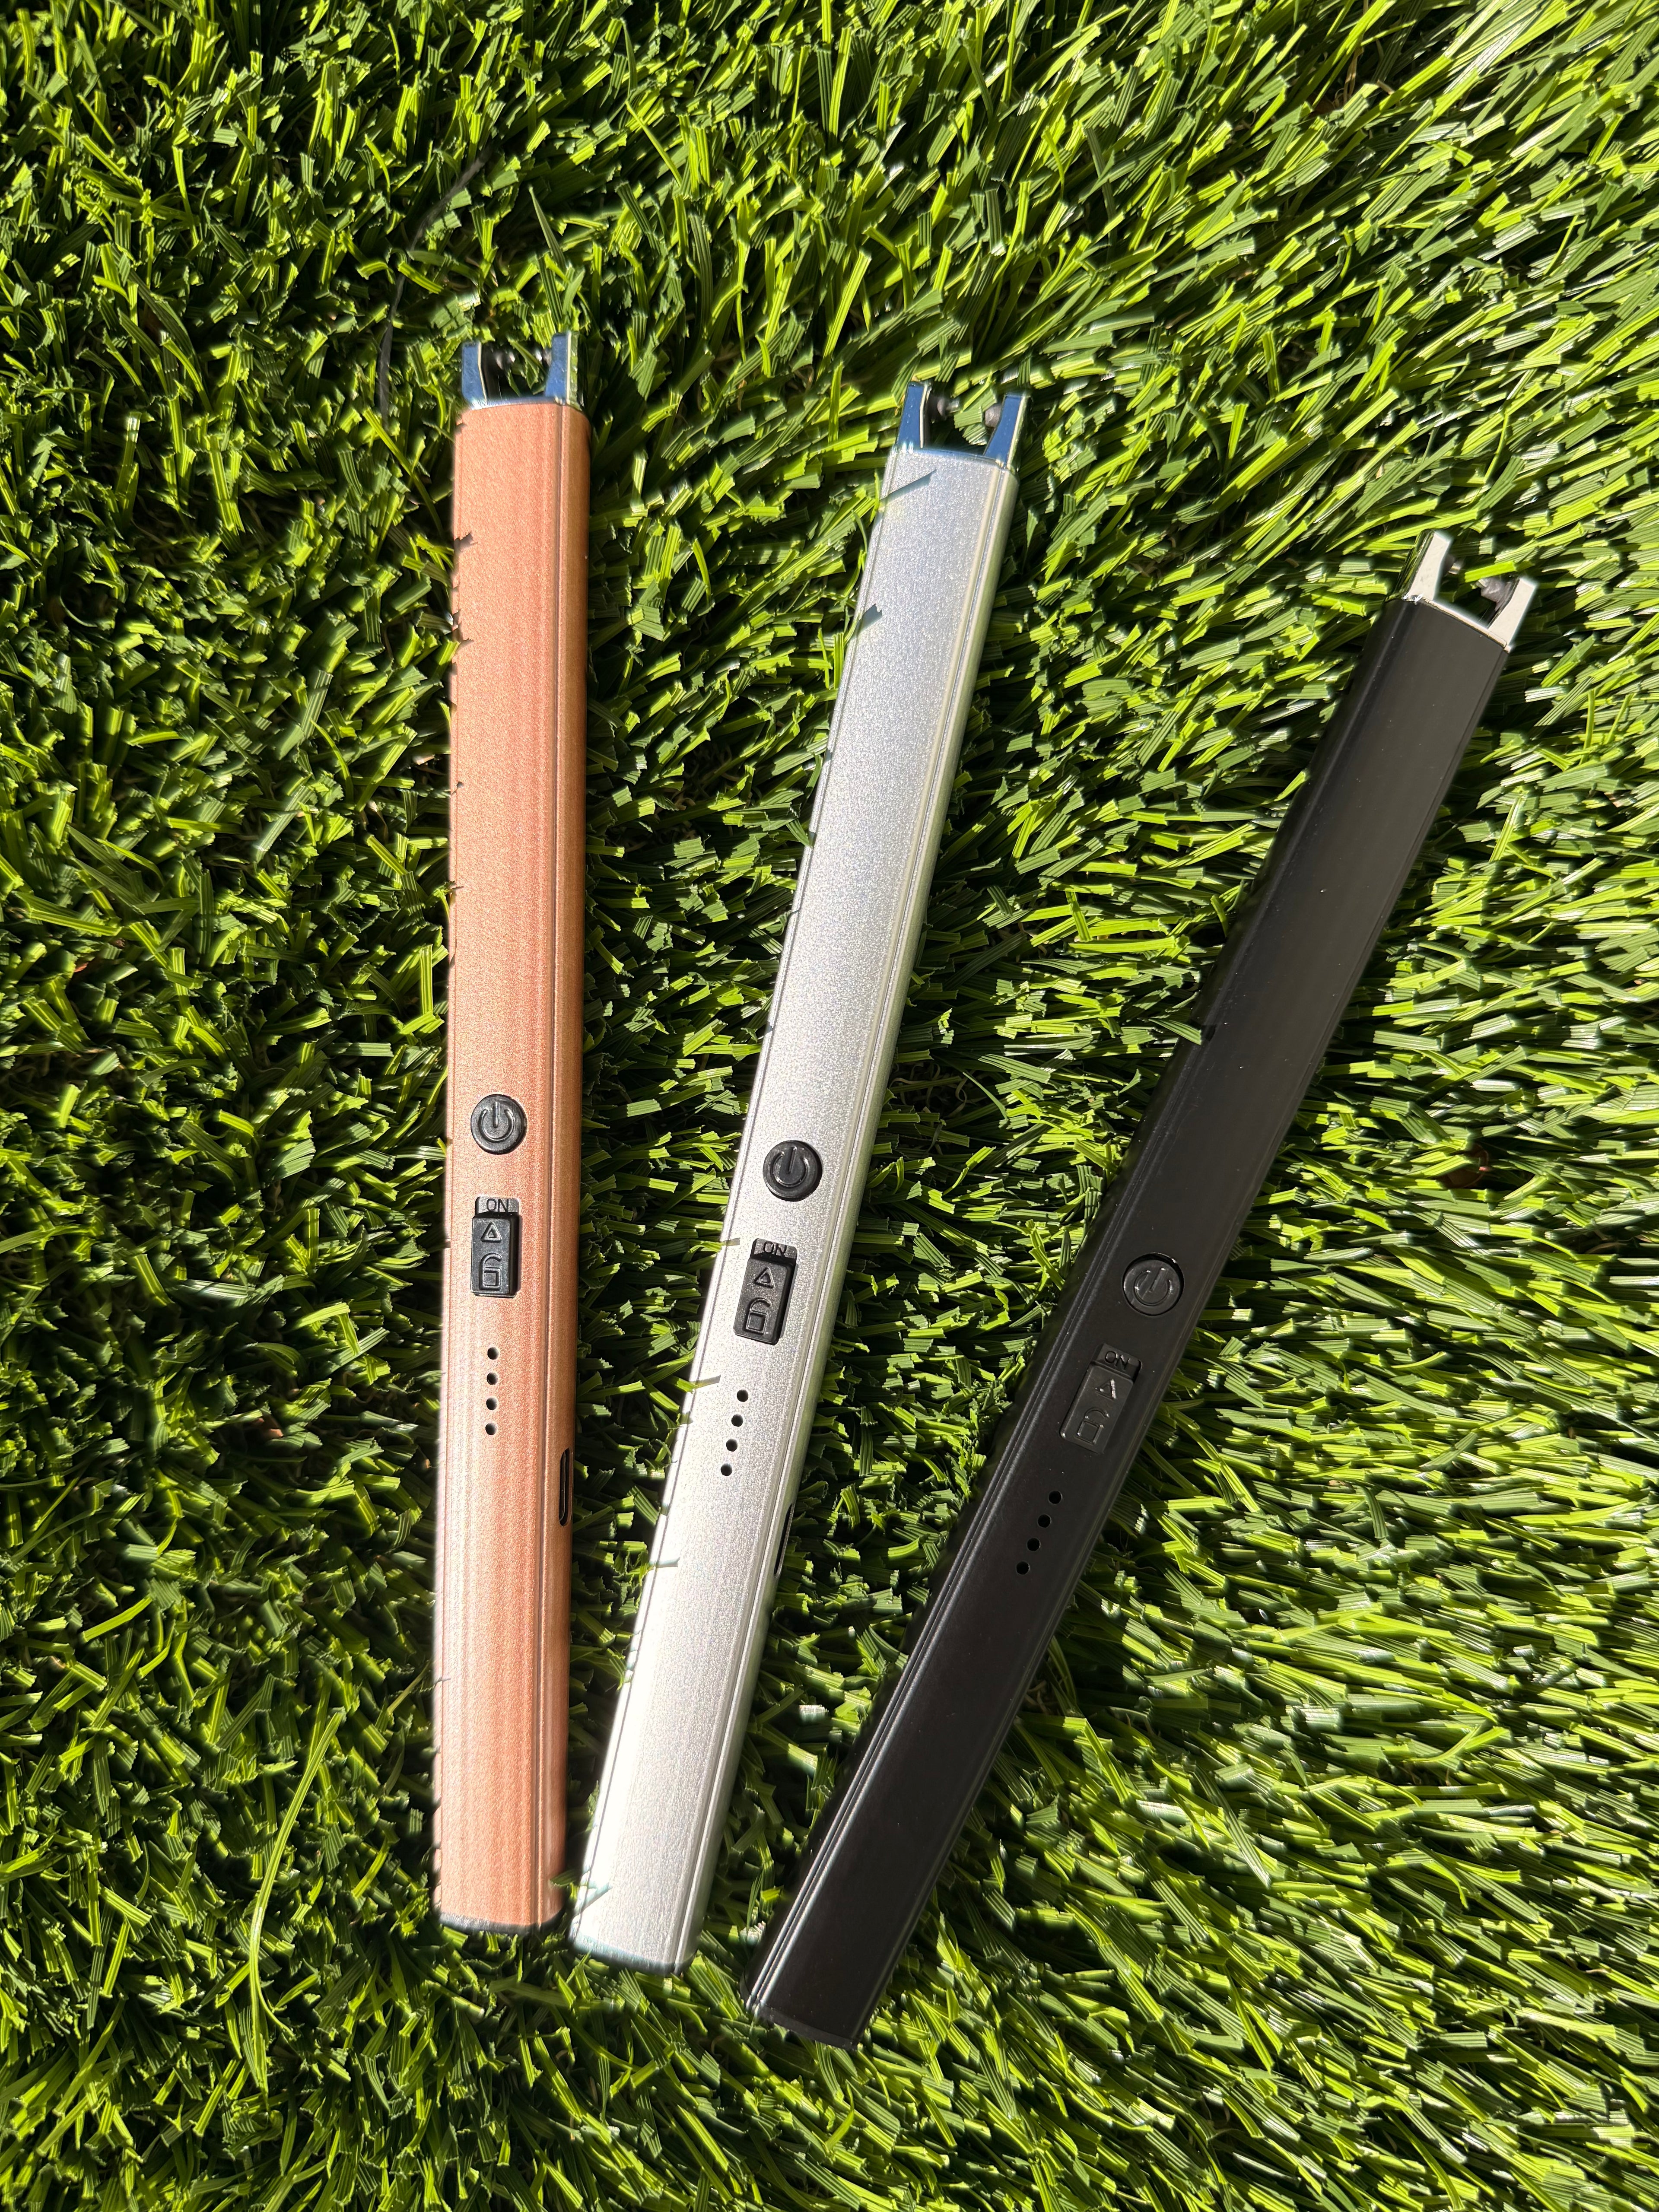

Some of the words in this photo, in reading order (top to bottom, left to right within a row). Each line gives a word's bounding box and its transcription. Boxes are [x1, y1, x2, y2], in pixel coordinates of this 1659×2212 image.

[486, 1198, 509, 1212] ON
[763, 1241, 787, 1257] ON
[1104, 1351, 1130, 1370] ON
